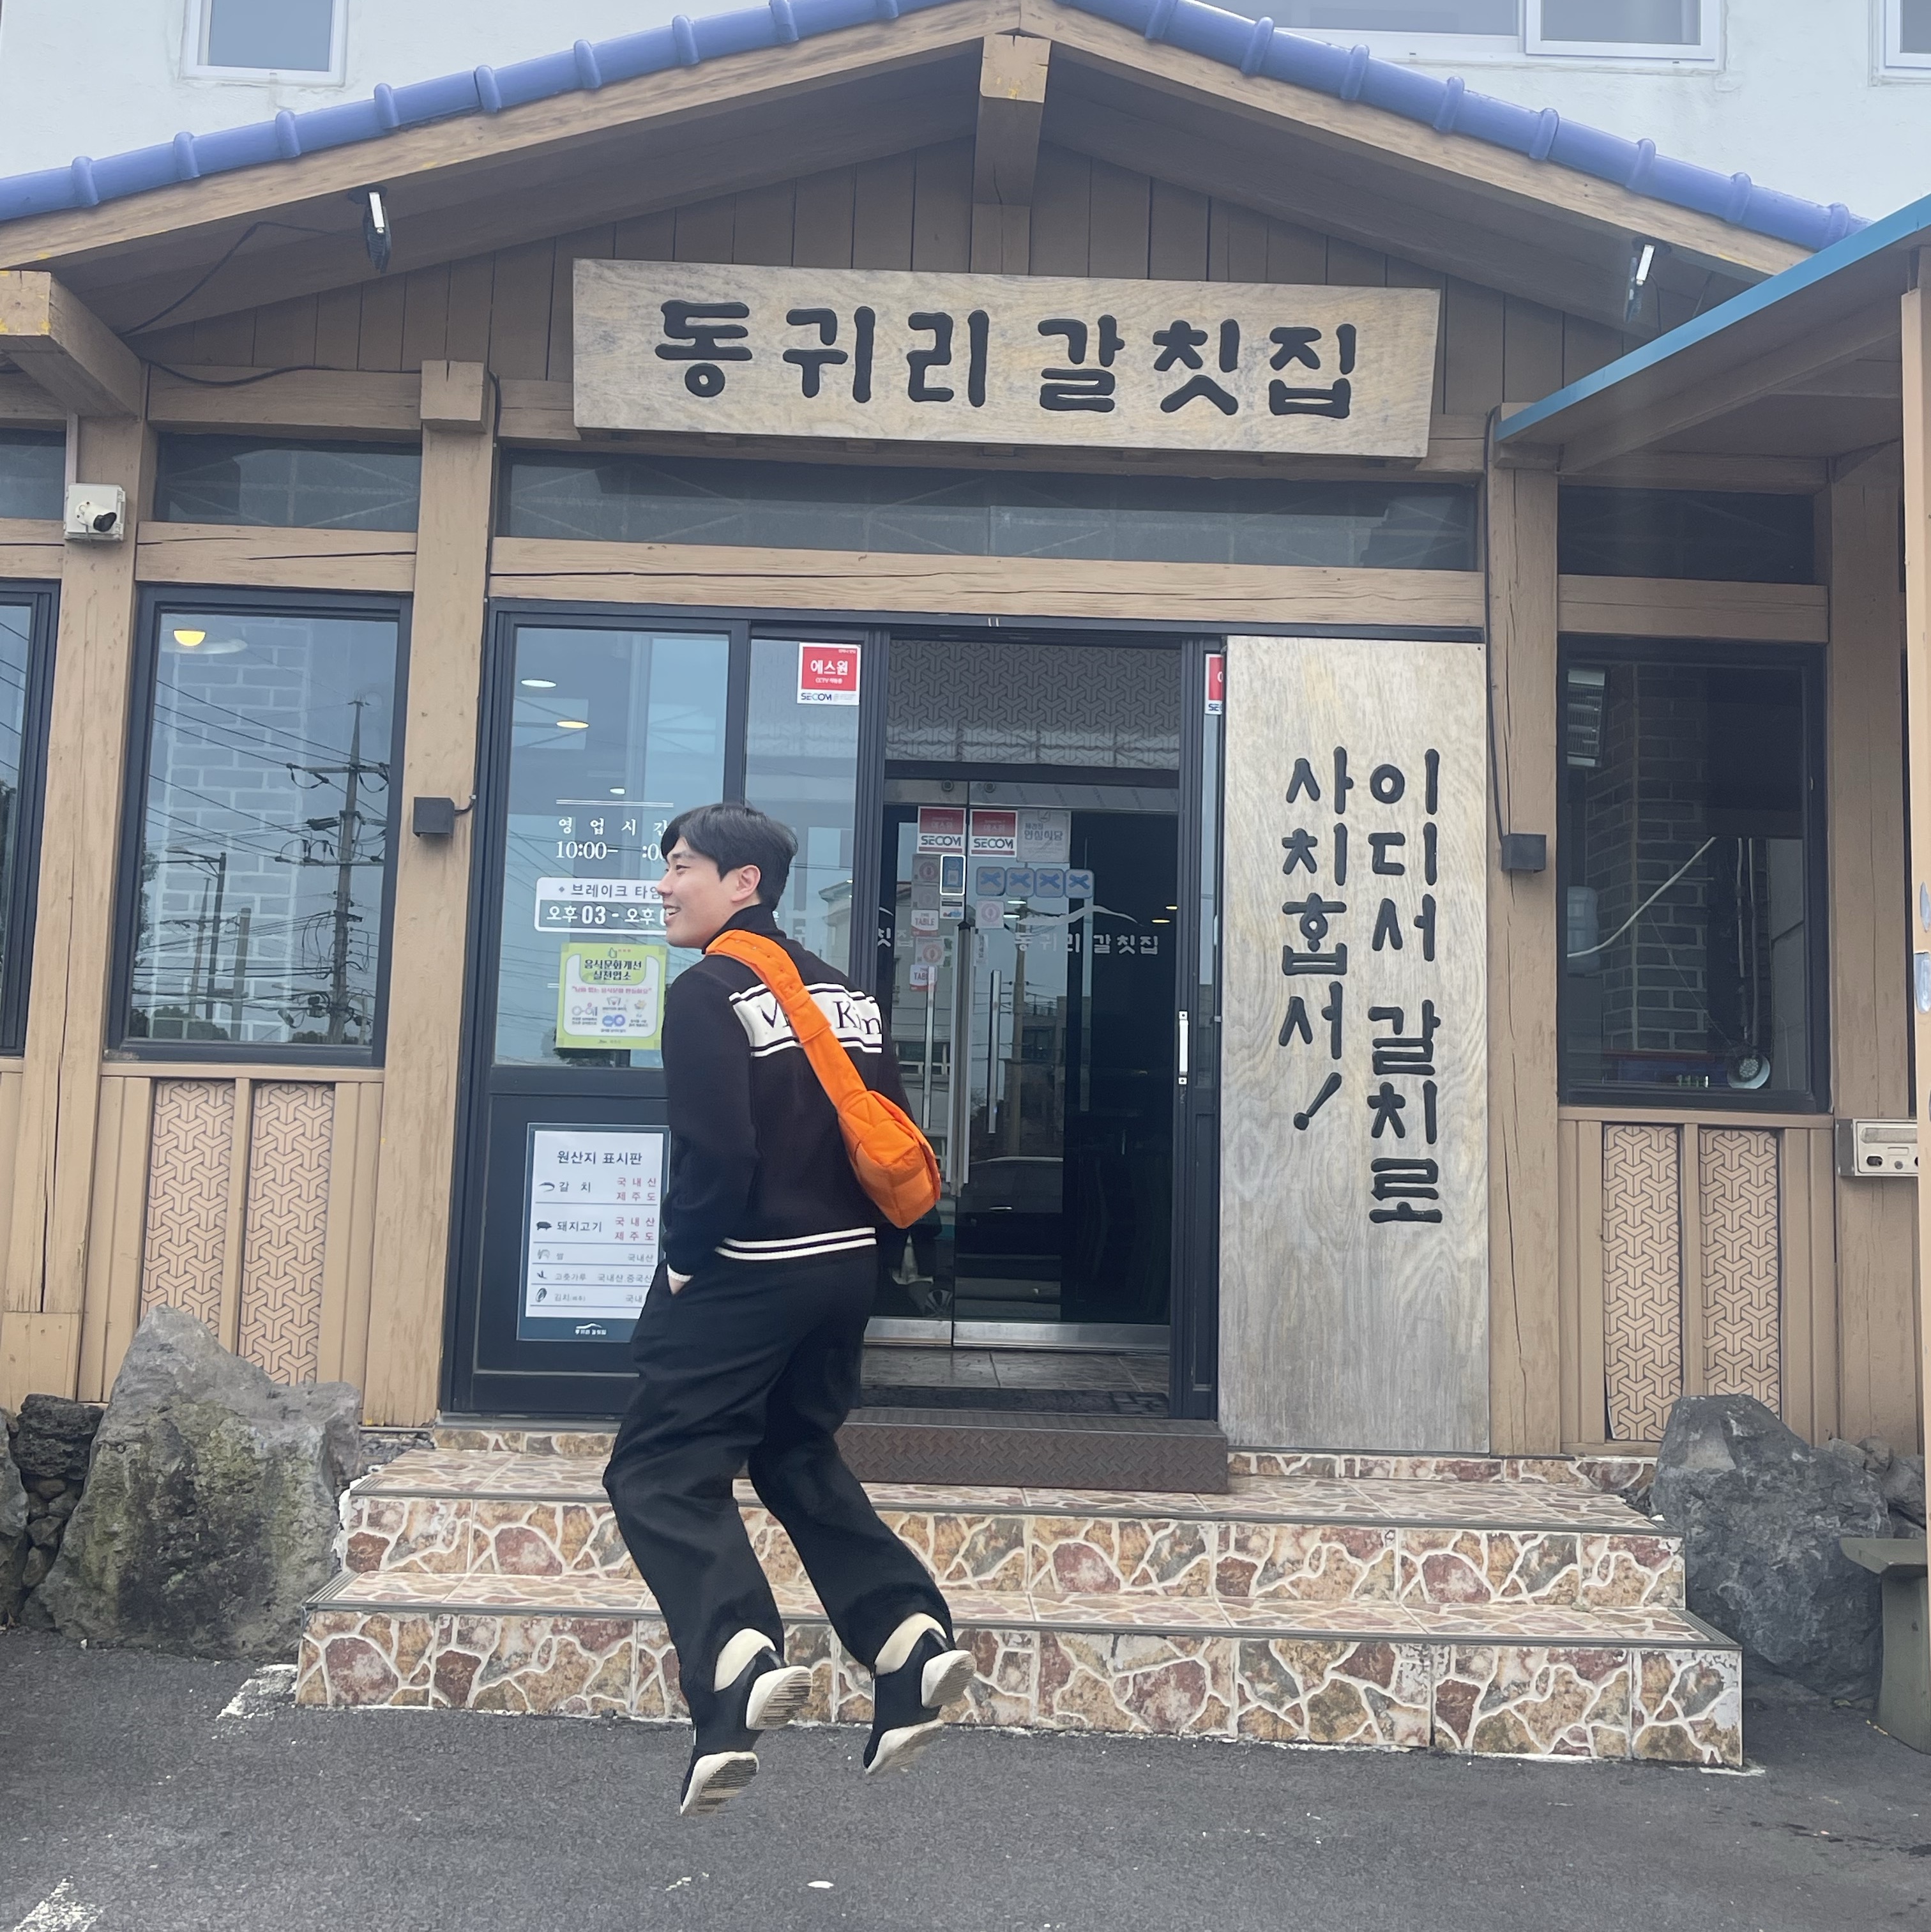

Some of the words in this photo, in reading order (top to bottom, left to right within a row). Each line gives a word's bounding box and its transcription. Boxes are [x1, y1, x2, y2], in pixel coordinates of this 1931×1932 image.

[655, 300, 988, 406] 동귀리
[1038, 314, 1358, 419] 갈칫집
[810, 659, 848, 676] 에스원
[801, 692, 832, 701] SECOM
[921, 835, 962, 847] SECOM
[974, 838, 1014, 849] SECOM
[1368, 748, 1440, 962] 이디서
[571, 883, 628, 898] 브레이크
[1093, 934, 1159, 955] 갈칫집
[557, 1150, 596, 1165] 원산지
[602, 1152, 643, 1166] 표시판
[556, 1221, 602, 1233] 돼지고기
[628, 1253, 654, 1263] 국내산
[625, 1295, 642, 1303] 국내
